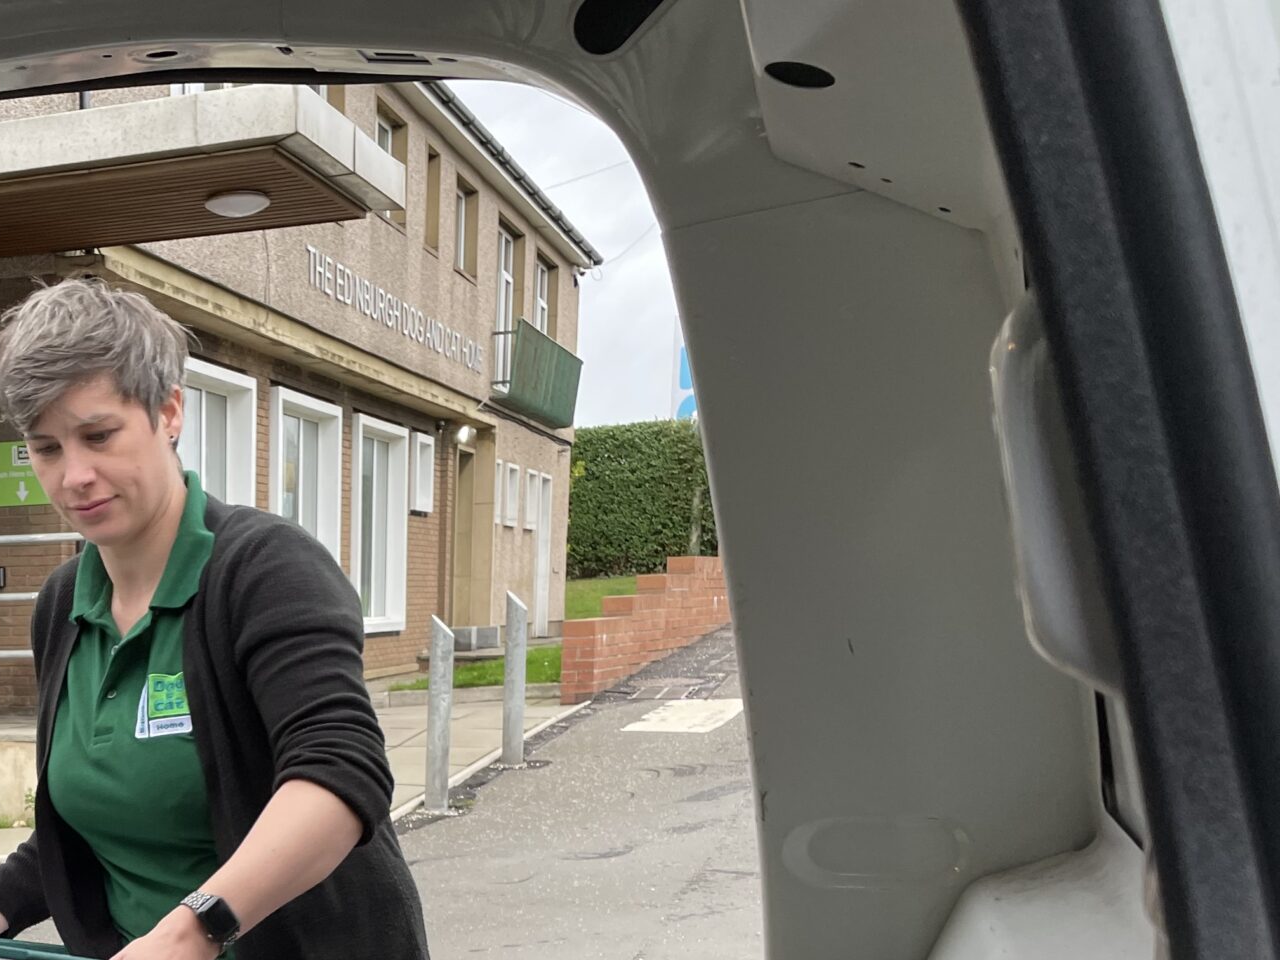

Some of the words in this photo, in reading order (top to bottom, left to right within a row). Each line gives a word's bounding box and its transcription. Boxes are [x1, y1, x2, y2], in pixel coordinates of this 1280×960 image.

[306, 244, 333, 297] THE
[336, 262, 401, 331] EDINBURGH
[402, 302, 424, 343] DOG
[425, 317, 444, 353] AND
[445, 328, 460, 361] CAT
[462, 337, 483, 374] HOME
[156, 721, 184, 730] Home
